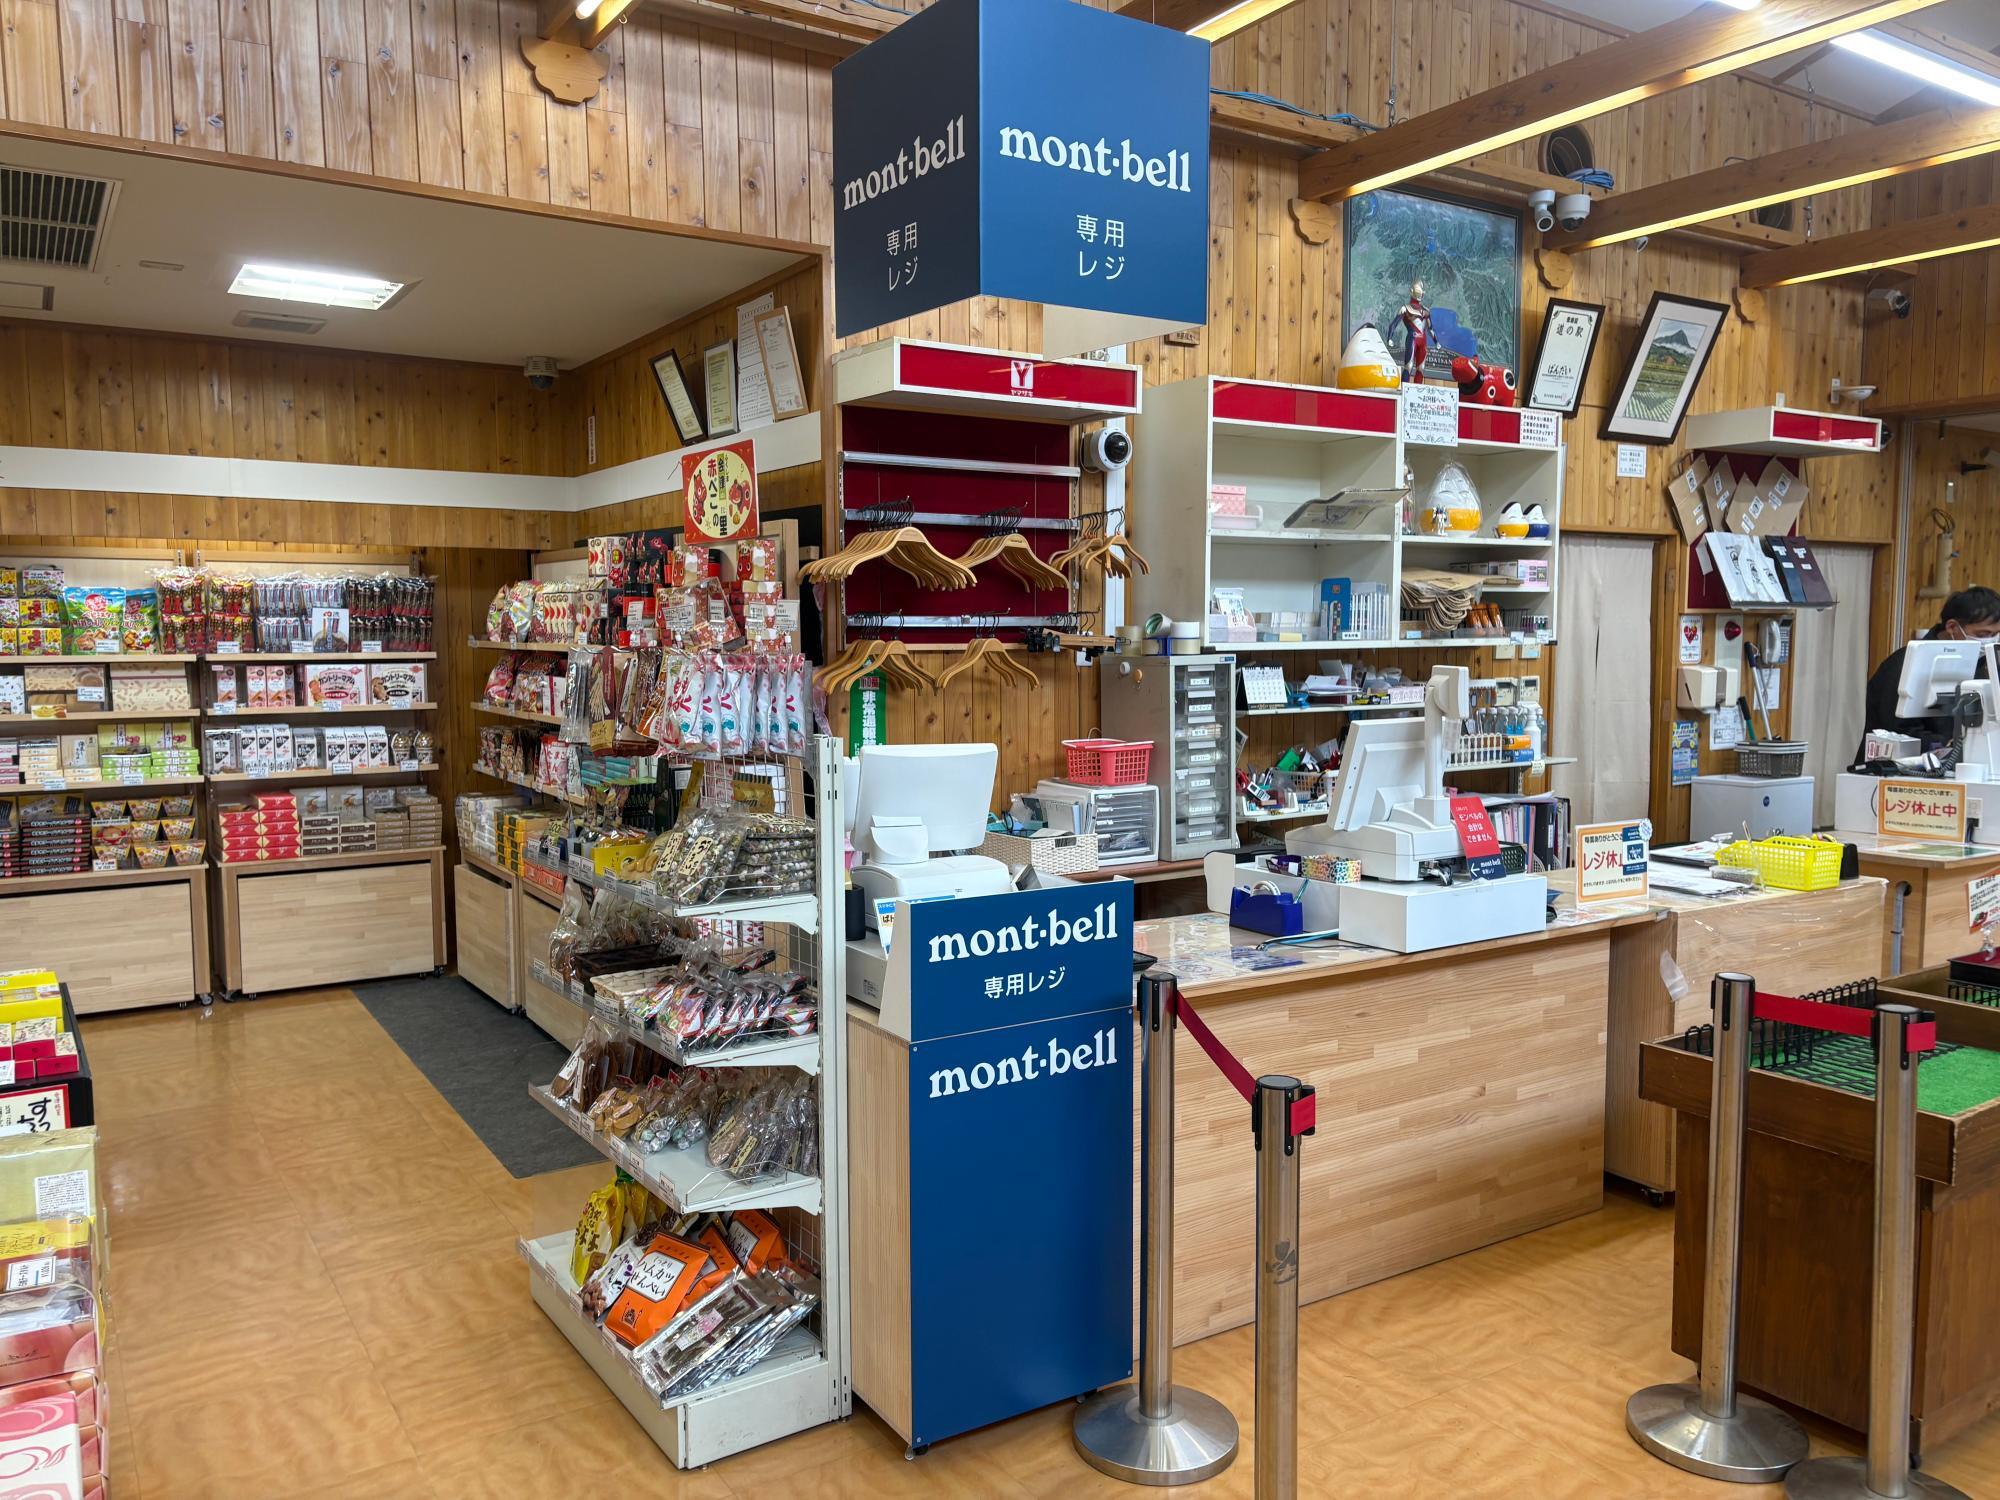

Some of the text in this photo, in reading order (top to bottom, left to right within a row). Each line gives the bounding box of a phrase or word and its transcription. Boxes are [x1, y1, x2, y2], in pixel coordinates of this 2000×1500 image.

[886, 222, 918, 257] 専用
[1076, 214, 1125, 249] 専用
[888, 256, 918, 291] レジ
[1078, 251, 1125, 281] レジ
[1556, 323, 1584, 337] 道の駅
[708, 459, 719, 527] 赤べこの
[1459, 812, 1484, 822] モンベルの
[1885, 799, 1957, 818] レジ休止中
[1466, 833, 1492, 843] できません
[1467, 823, 1484, 832] 会計は
[984, 966, 1066, 999] 専用レジ
